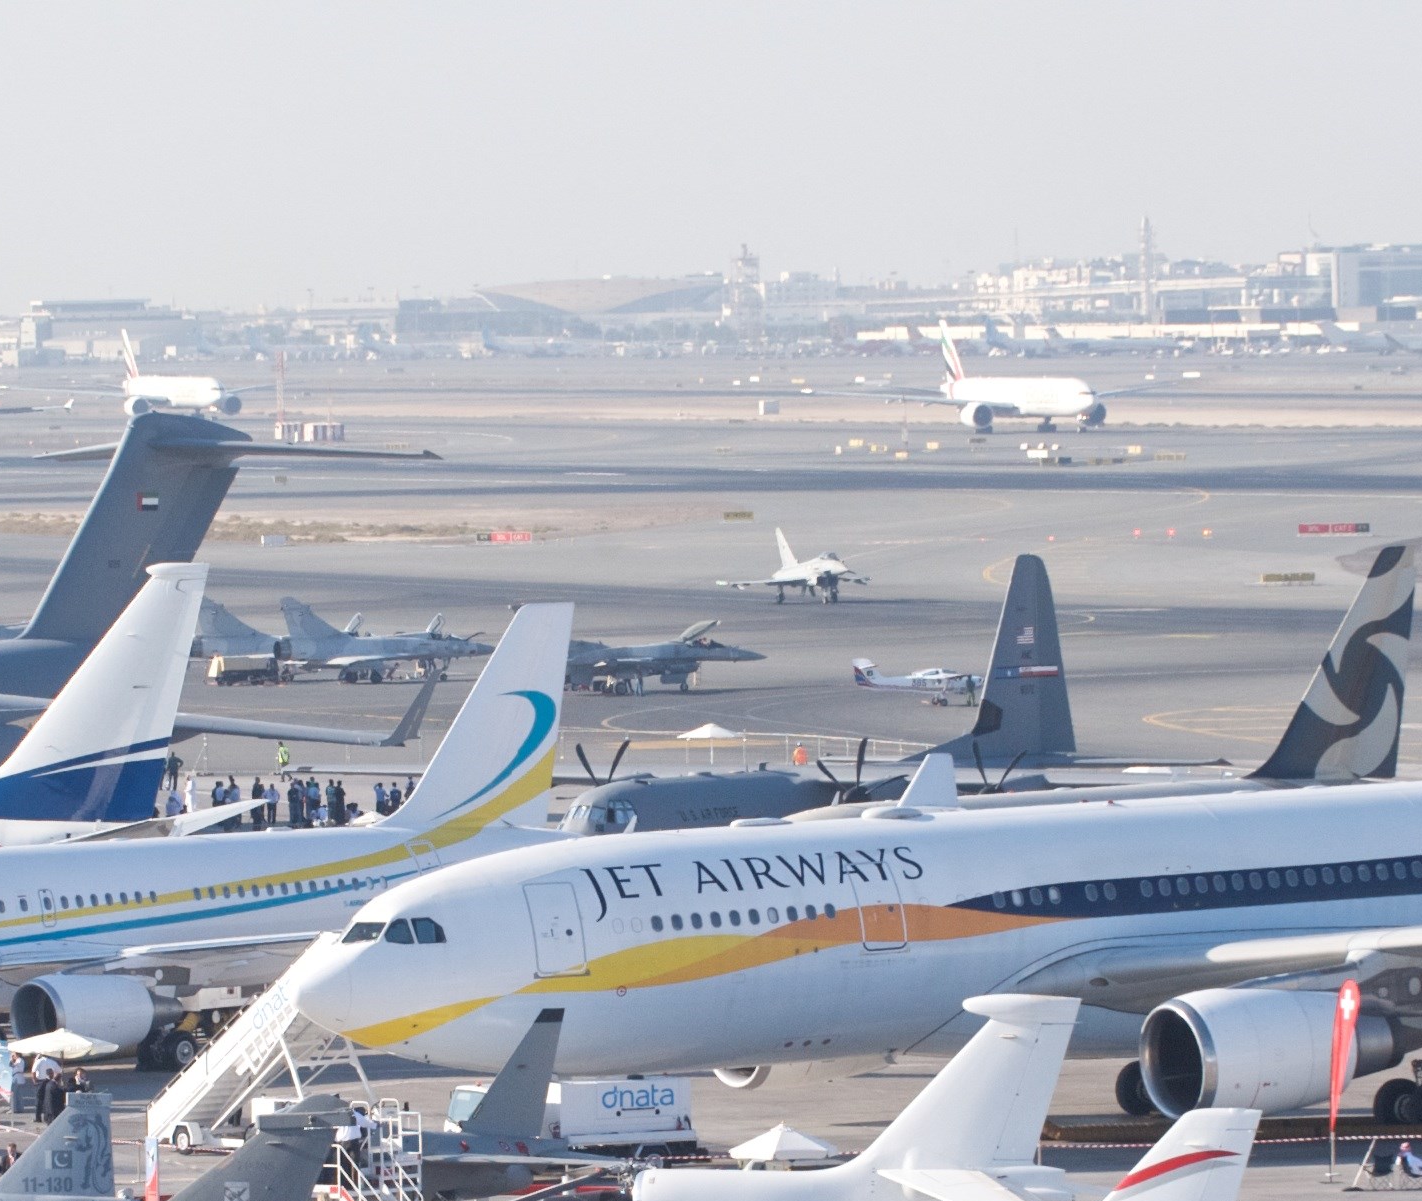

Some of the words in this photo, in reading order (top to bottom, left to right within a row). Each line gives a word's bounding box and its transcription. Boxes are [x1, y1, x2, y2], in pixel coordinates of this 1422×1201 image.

[581, 862, 662, 922] JET
[695, 845, 924, 894] AIRWAYS
[253, 984, 289, 1029] dnat
[602, 1085, 675, 1109] dnata
[22, 1176, 73, 1193] 11-130
